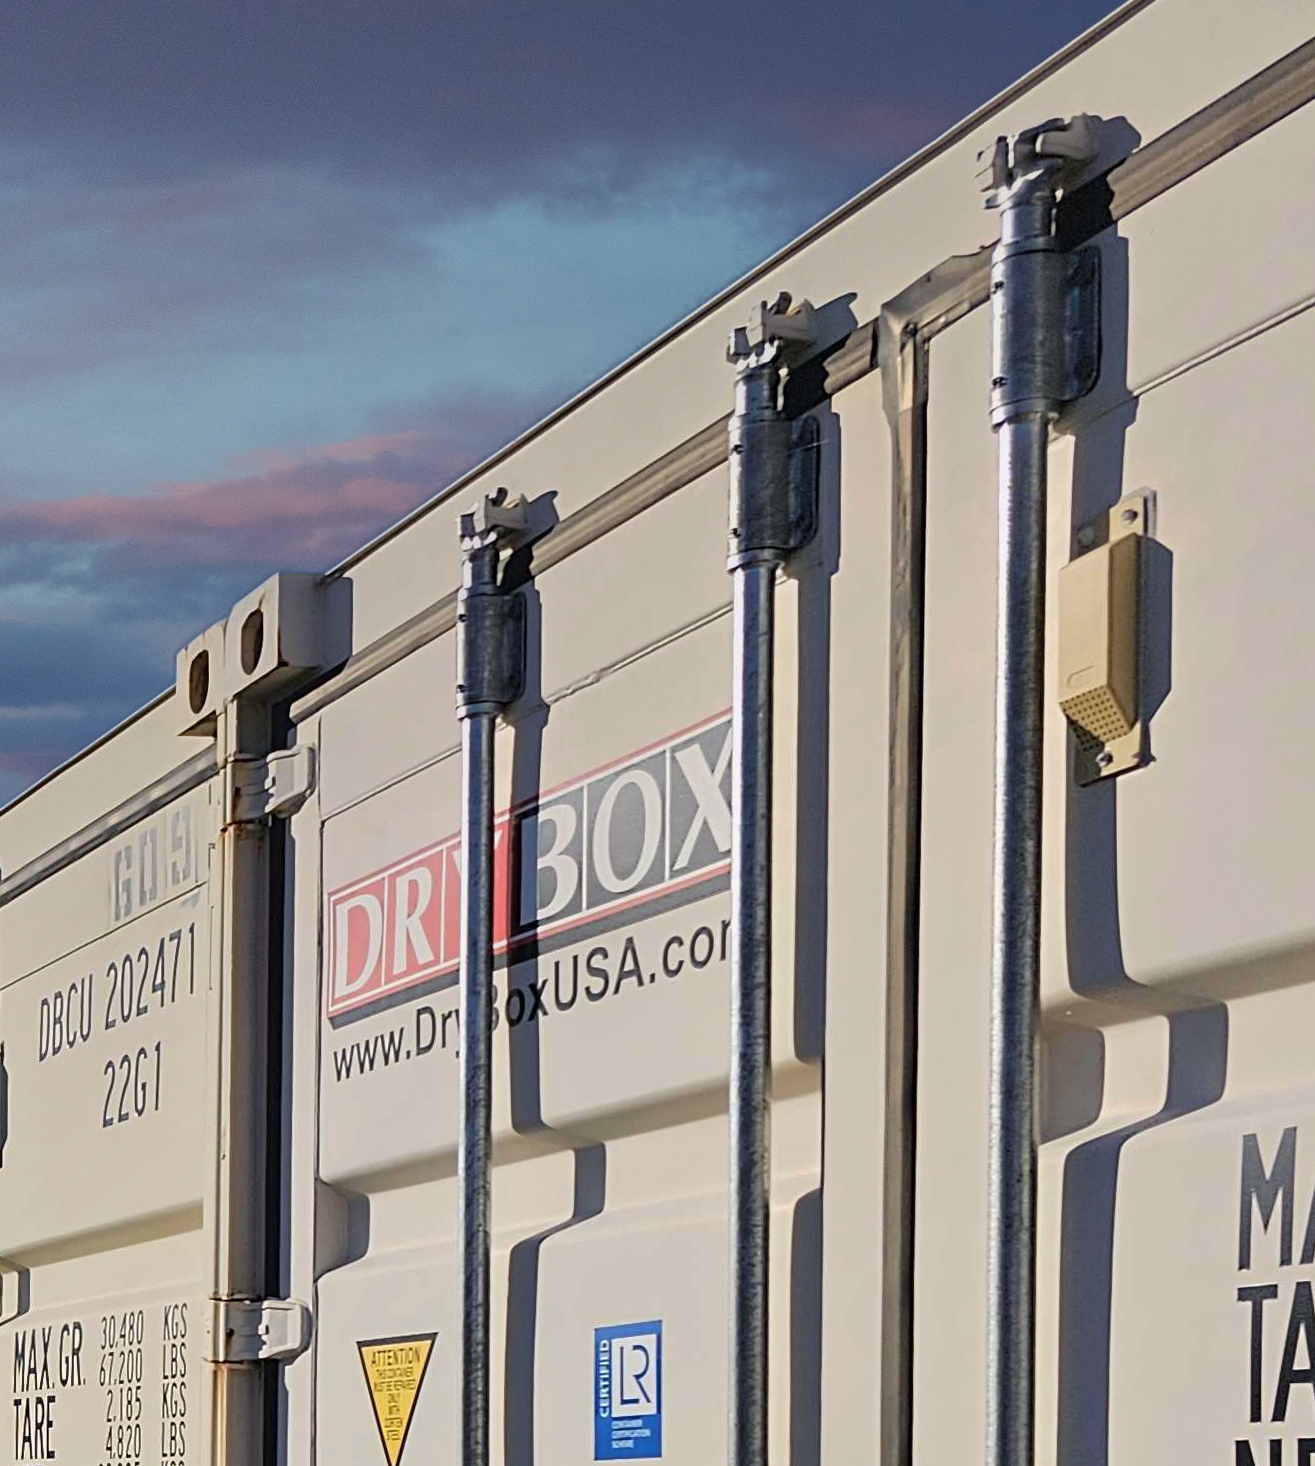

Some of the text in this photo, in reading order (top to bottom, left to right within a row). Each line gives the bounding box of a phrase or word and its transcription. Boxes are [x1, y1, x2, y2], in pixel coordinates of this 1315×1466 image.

[38, 922, 195, 1063] DBCU 202471
[102, 1041, 161, 1128] 22G1
[163, 1303, 188, 1341] KGS
[162, 1342, 187, 1380] LBS
[371, 1346, 421, 1367] ATTENTION
[598, 1339, 610, 1418] CERTIFIED
[161, 1381, 187, 1419] KGS
[13, 1396, 56, 1461] TARE
[161, 1421, 186, 1458] LBS
